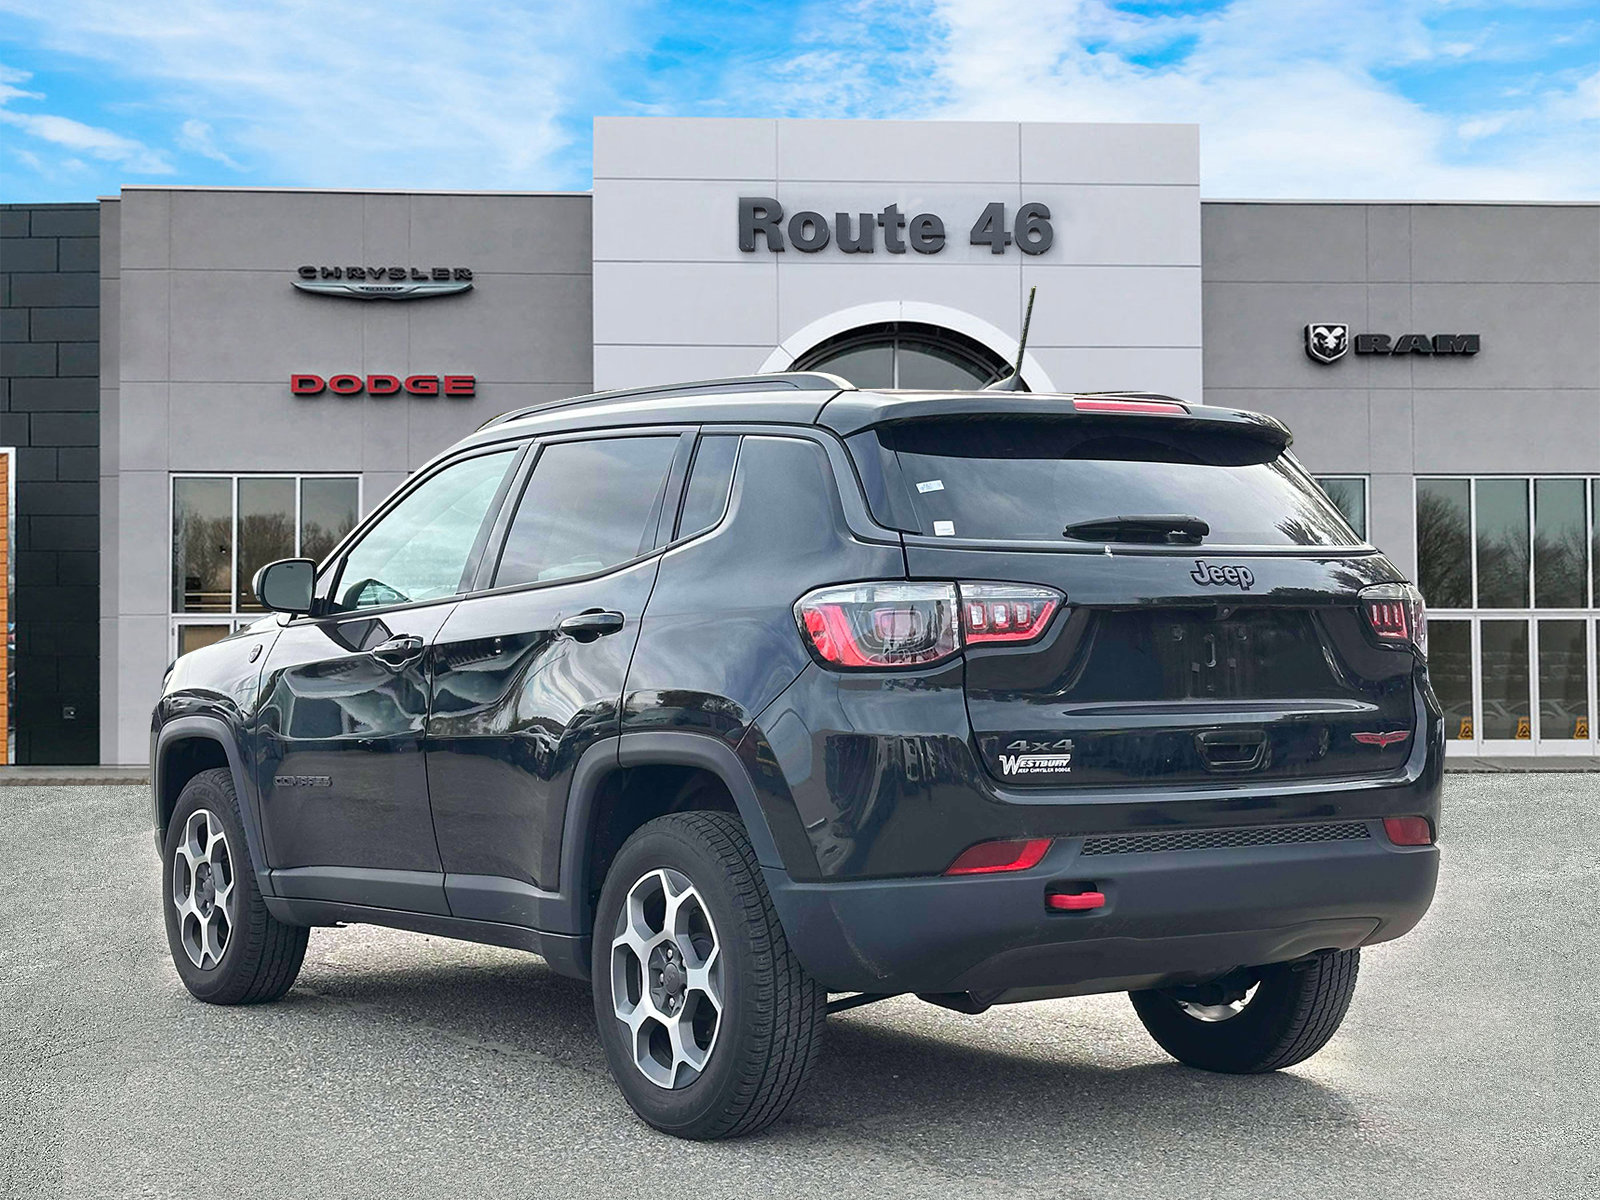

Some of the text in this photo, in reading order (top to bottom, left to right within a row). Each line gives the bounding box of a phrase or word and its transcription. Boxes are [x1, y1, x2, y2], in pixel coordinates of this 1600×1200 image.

[738, 196, 1055, 256] Route 46
[297, 265, 474, 281] CHRYSLER
[1354, 333, 1481, 356] RAM
[290, 373, 477, 397] DODGE
[1189, 559, 1255, 591] Jeep
[1006, 738, 1076, 753] 4x4
[998, 753, 1072, 776] WESTBURY
